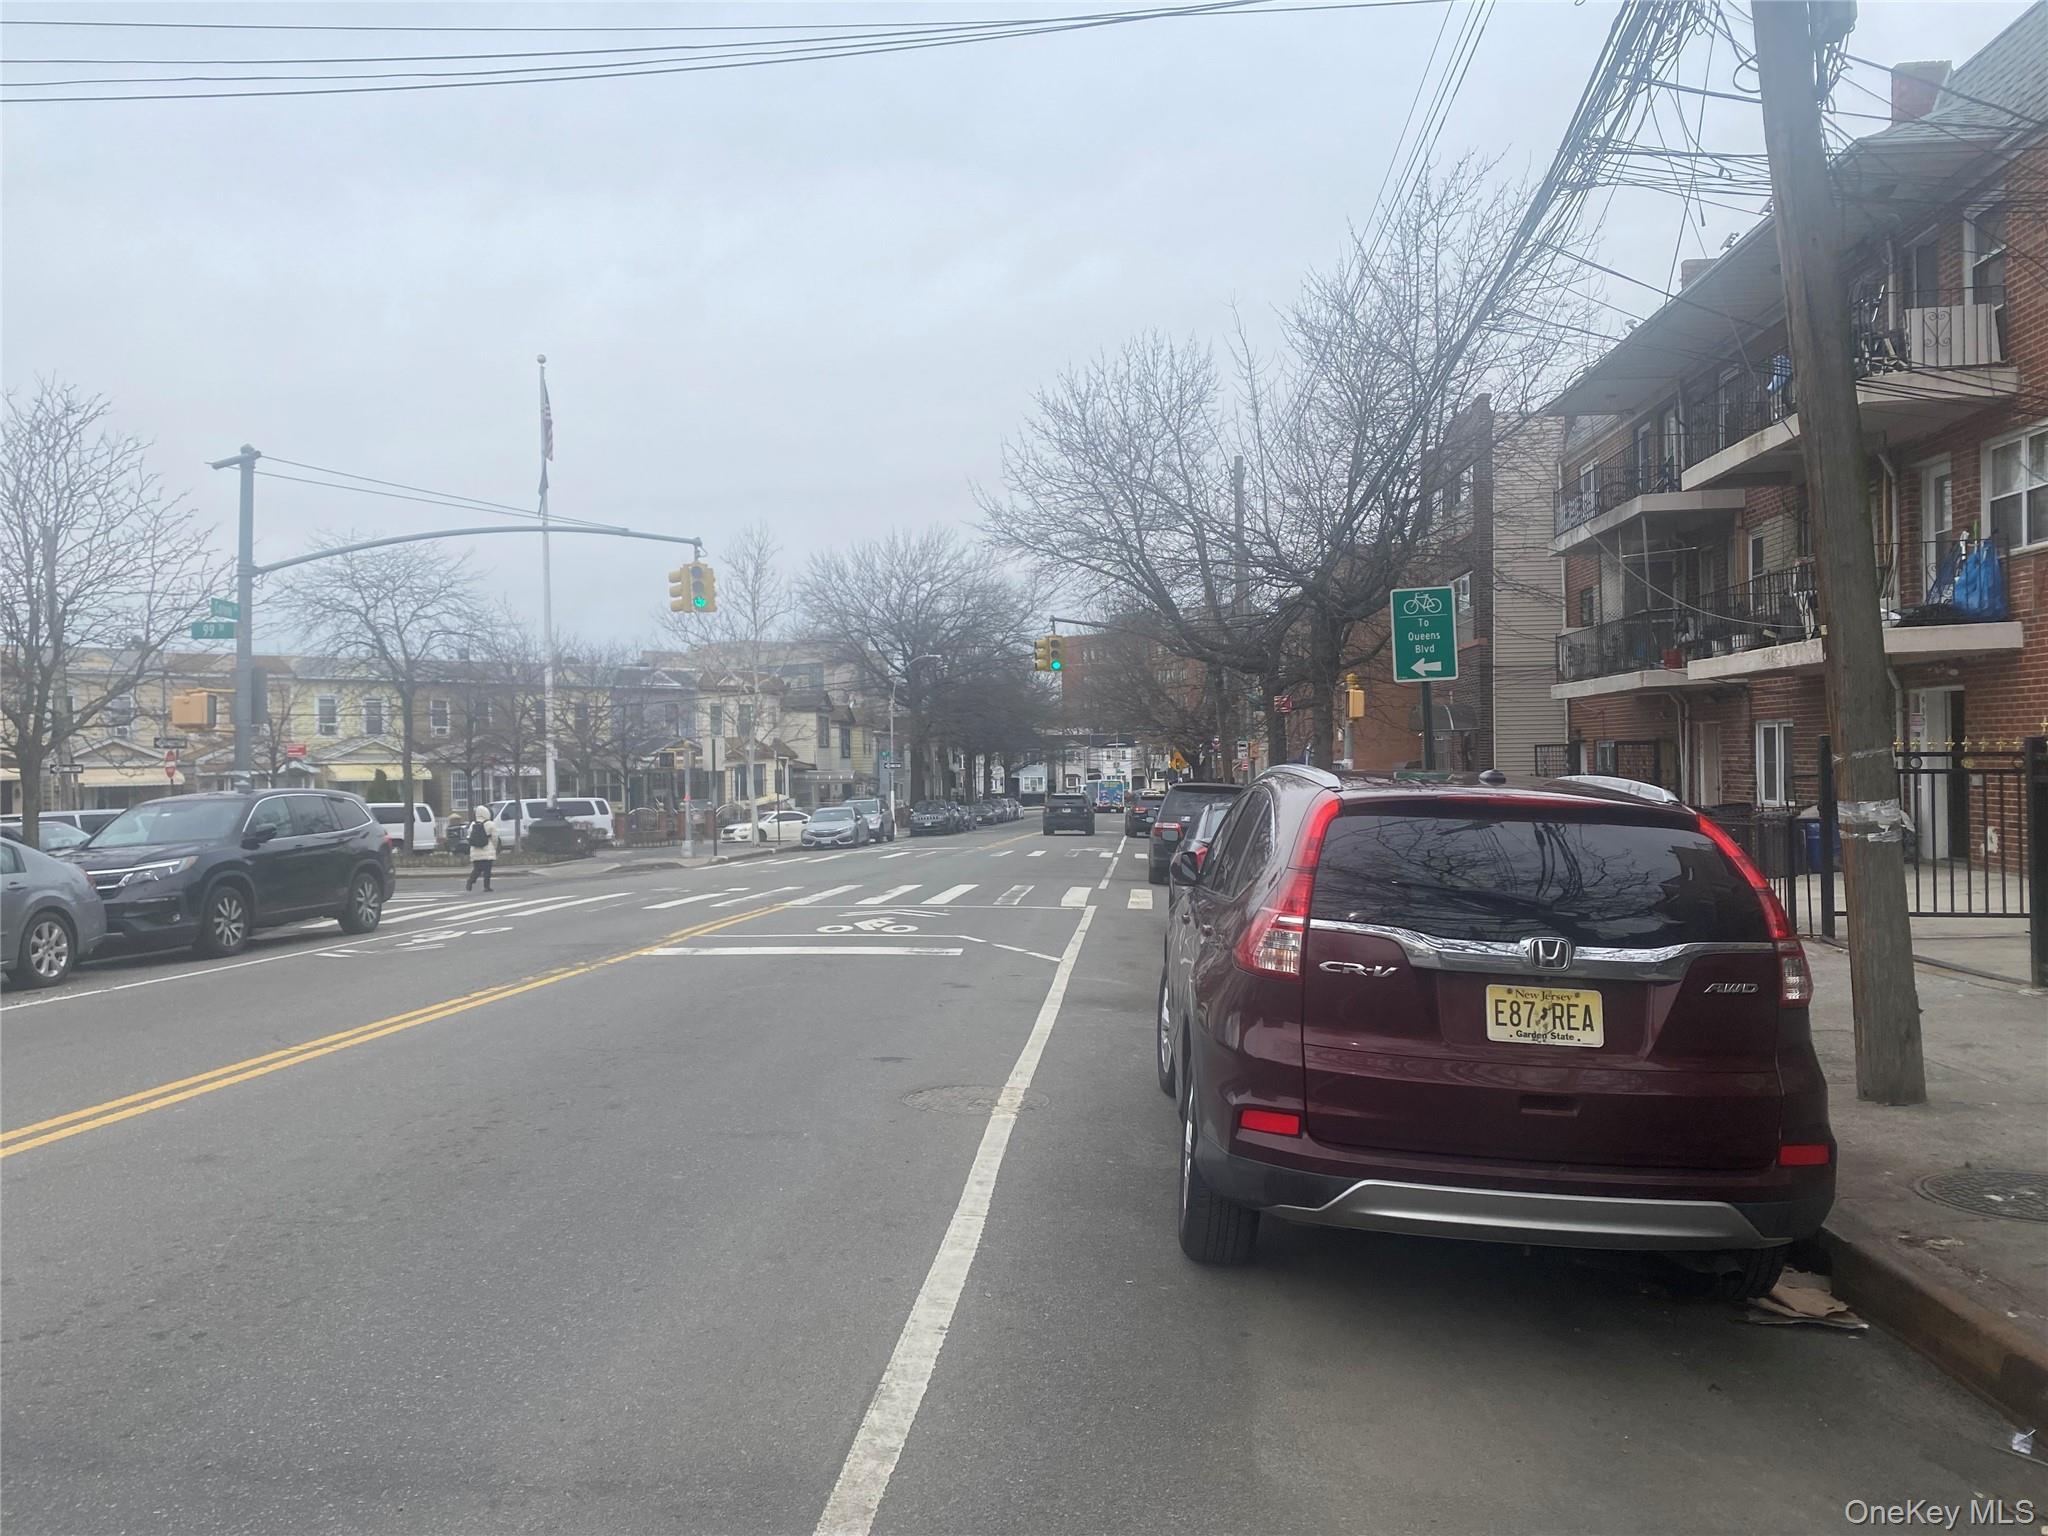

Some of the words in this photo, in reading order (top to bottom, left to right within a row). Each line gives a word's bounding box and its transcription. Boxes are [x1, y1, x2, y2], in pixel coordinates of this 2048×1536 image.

[1418, 618, 1429, 627] To
[202, 624, 215, 637] 99
[1408, 632, 1440, 641] Queens
[1415, 644, 1435, 653] Blvd
[1319, 961, 1398, 977] CR-V
[1704, 983, 1759, 993] AWD
[1515, 989, 1538, 1000] New
[1541, 990, 1572, 1001] Jersey
[1495, 999, 1535, 1028] E87
[1551, 1003, 1594, 1032] REA
[1516, 1030, 1547, 1040] Garden
[1551, 1032, 1574, 1041] State
